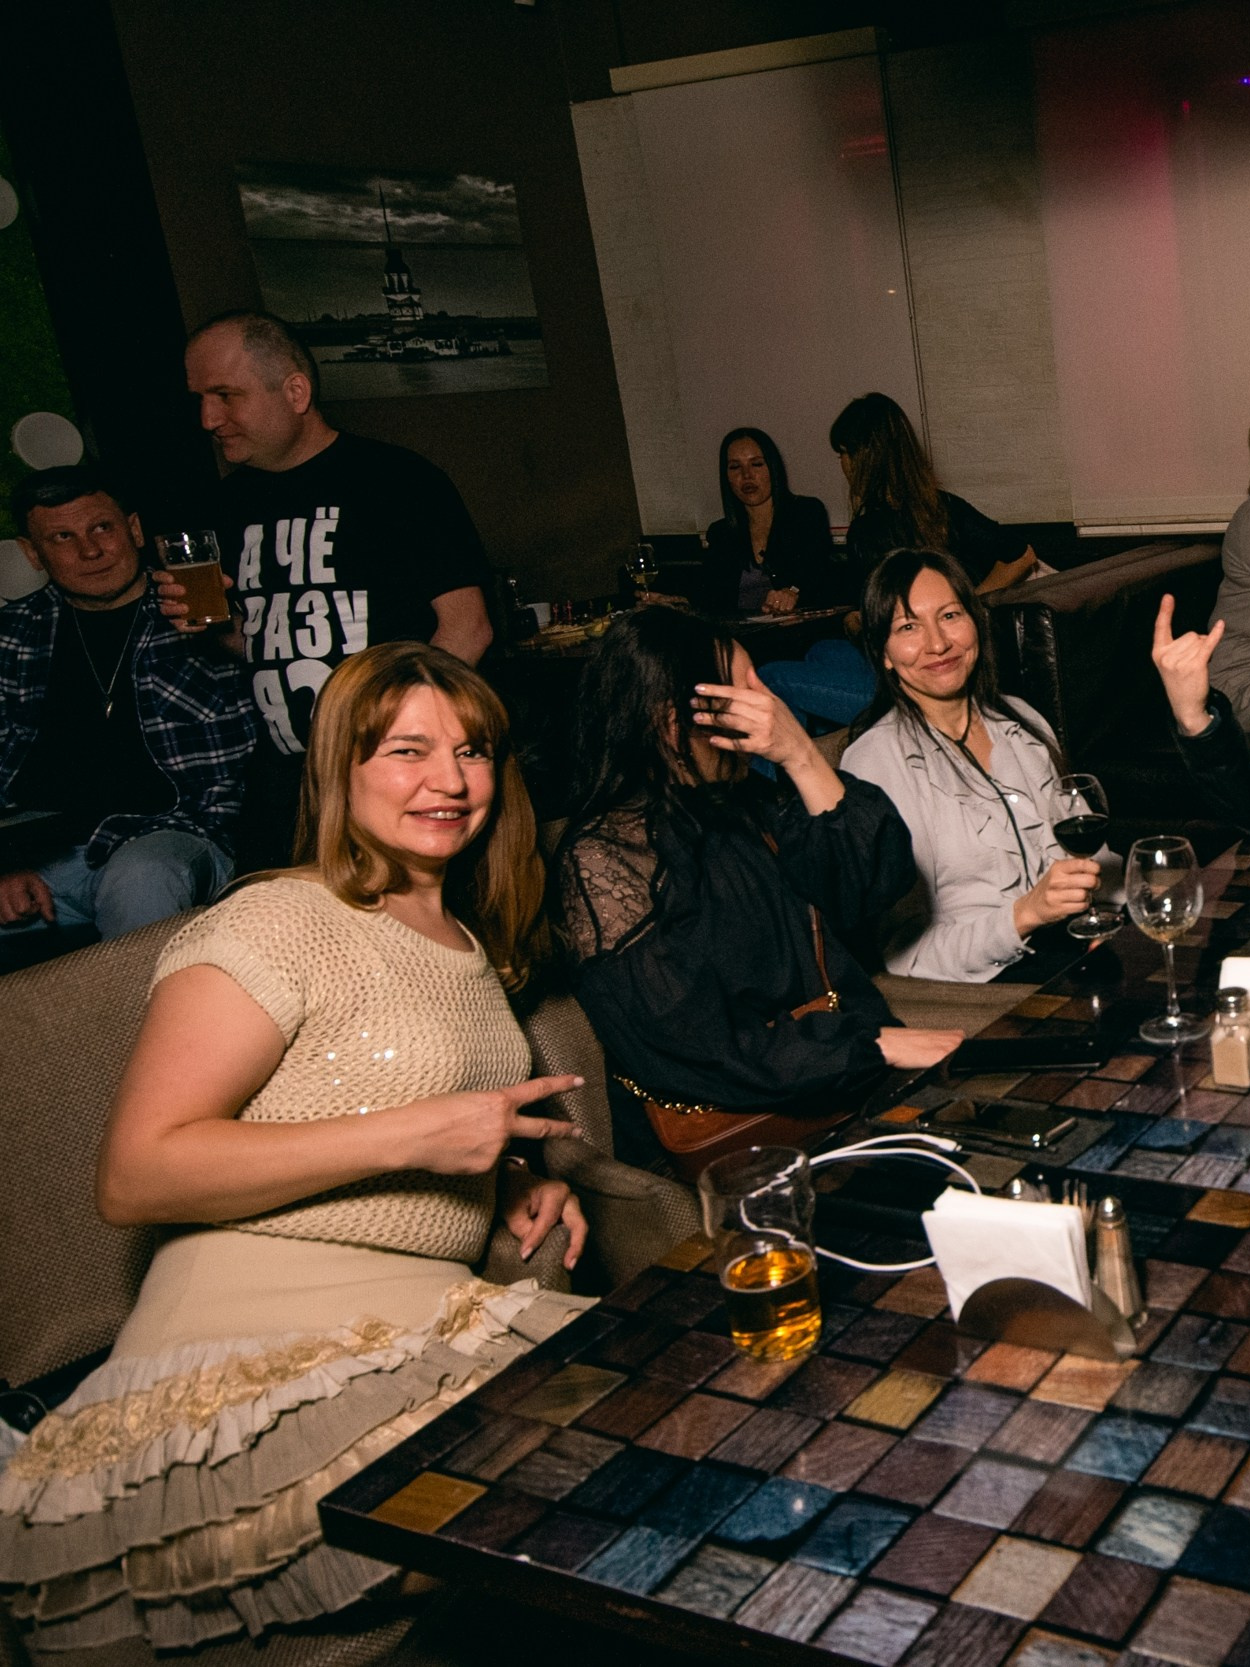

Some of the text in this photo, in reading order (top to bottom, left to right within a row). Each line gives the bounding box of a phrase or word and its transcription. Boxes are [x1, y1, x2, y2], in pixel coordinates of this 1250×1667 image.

[237, 506, 340, 591] А ЧЁ
[235, 590, 368, 663] РАЗУ
